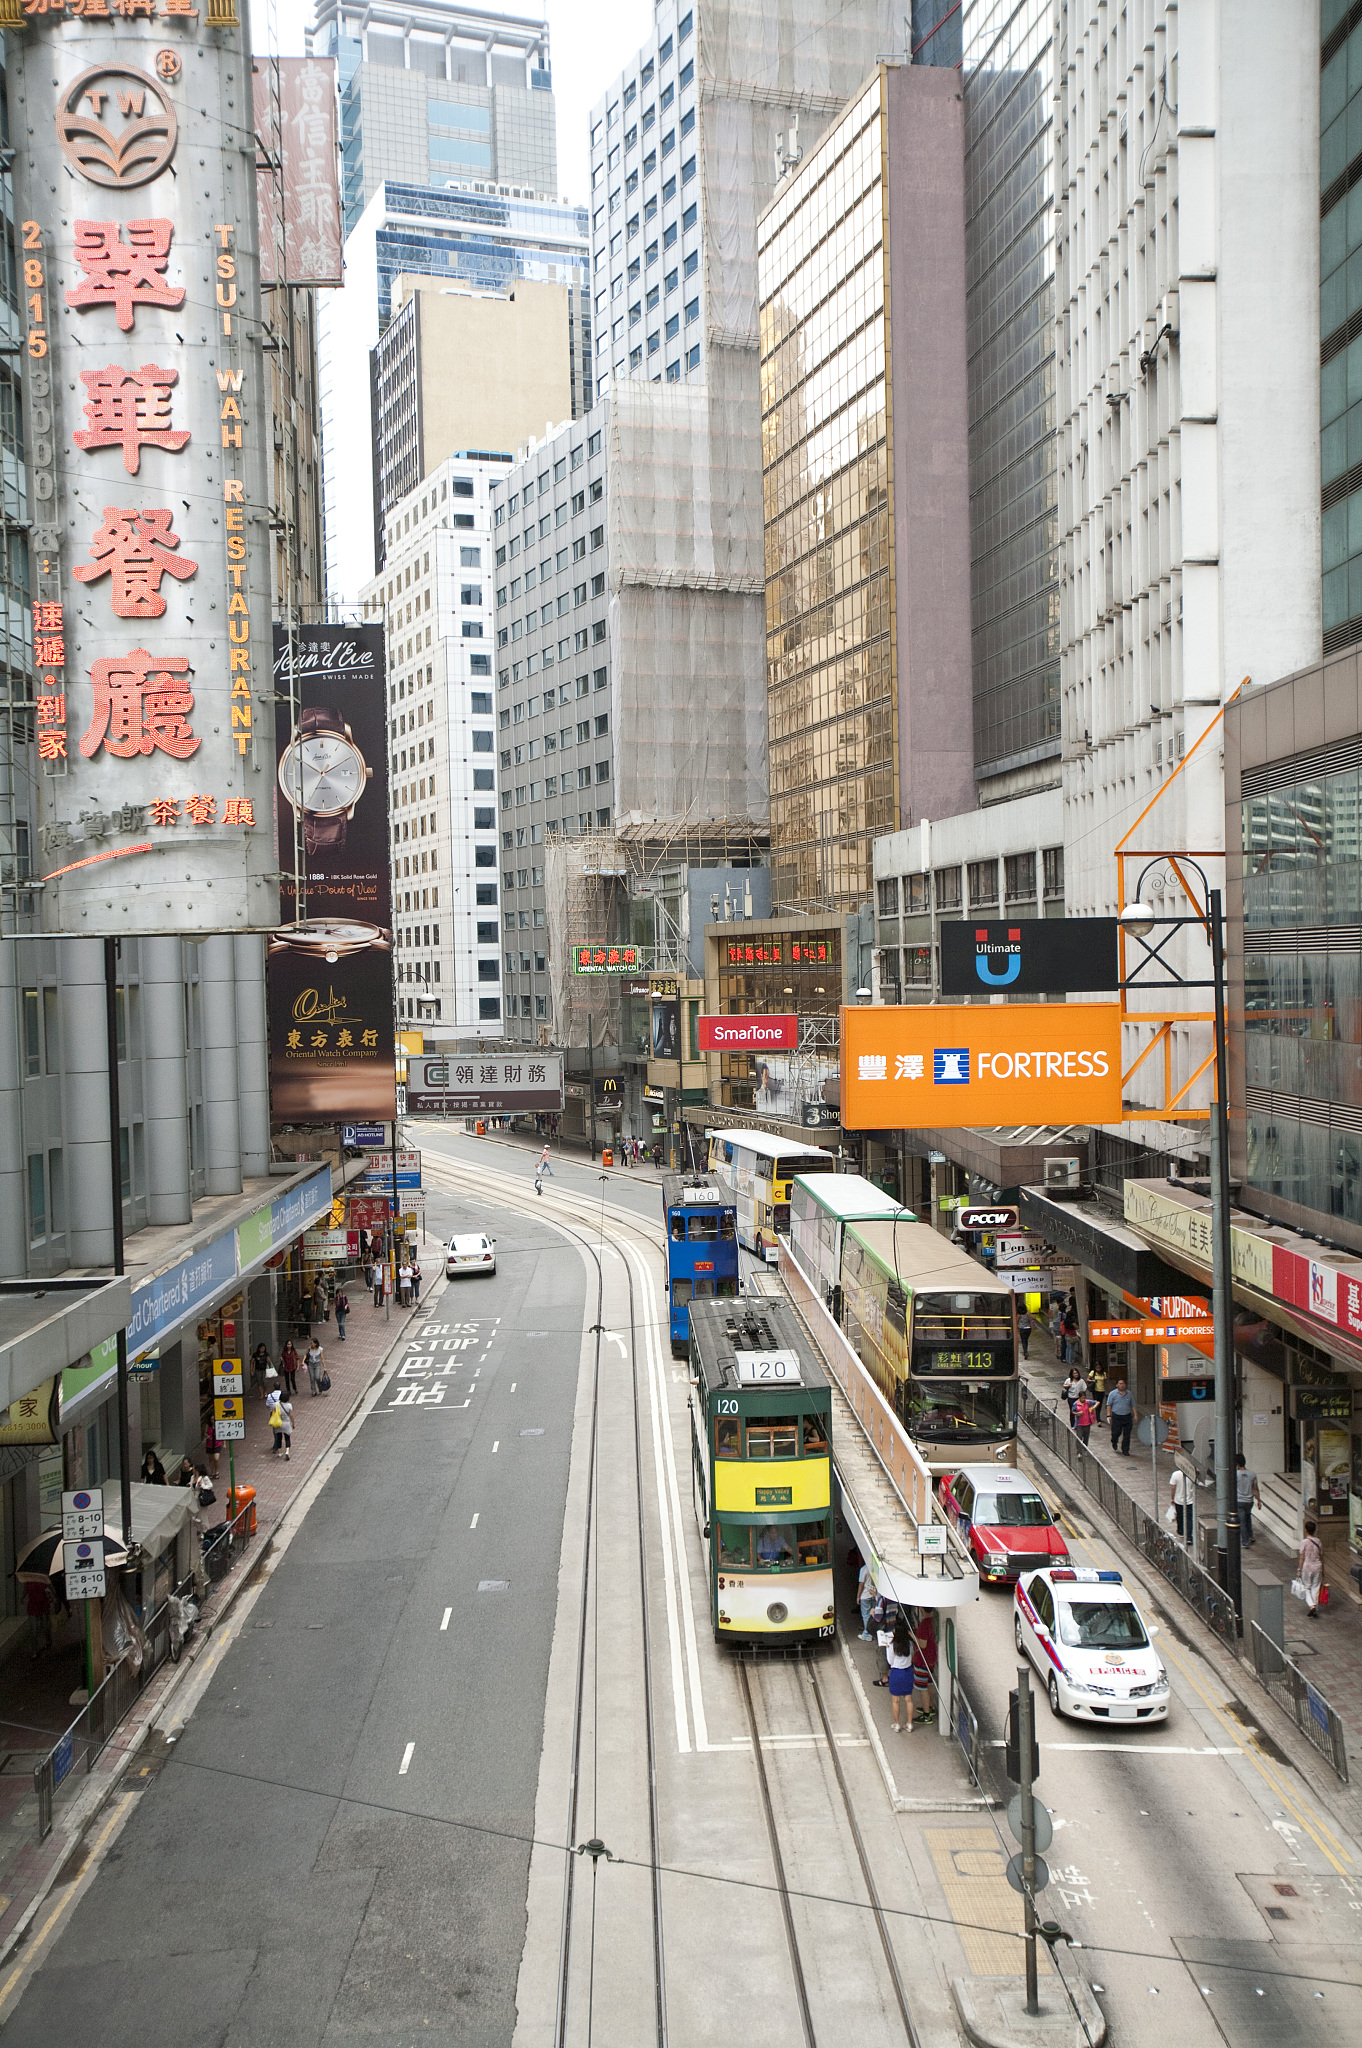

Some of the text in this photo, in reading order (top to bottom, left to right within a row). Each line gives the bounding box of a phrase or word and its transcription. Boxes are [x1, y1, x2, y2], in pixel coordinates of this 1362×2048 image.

[21, 220, 48, 358] 2815
[30, 368, 54, 500] 3000
[64, 218, 202, 759] 翠華餐廳
[214, 224, 252, 756] TSUI WAH RESTAURANT
[315, 884, 346, 896] Point
[347, 884, 356, 897] of
[356, 882, 377, 896] View
[976, 943, 1021, 953] Ultimate
[578, 965, 605, 973] ORIENTAL
[285, 1028, 379, 1050] 東方表行
[714, 1025, 783, 1042] SmarTone
[285, 1049, 379, 1059] Oriental Watch Company
[317, 1060, 333, 1068] Since
[857, 1054, 925, 1081] 豐澤
[978, 1050, 1110, 1079] FORTRESS
[455, 1064, 546, 1084] 領達財務
[693, 1191, 714, 1201] 160
[968, 1213, 1010, 1225] PCCW
[142, 1279, 180, 1327] Chartered
[420, 1323, 480, 1337] BUS
[406, 1337, 480, 1352] STOP
[937, 1352, 962, 1363] 彩虹
[967, 1352, 992, 1368] 113
[396, 1354, 464, 1380] 巴士
[751, 1361, 786, 1379] 120
[219, 1384, 238, 1393] 終止
[388, 1380, 449, 1406] 站
[19, 1398, 39, 1418] 家
[717, 1399, 739, 1414] 120
[26, 1422, 47, 1431] 3000
[227, 1421, 243, 1429] 7-10
[78, 1513, 101, 1523] 8-10
[78, 1525, 98, 1536] 5-7
[80, 1574, 103, 1584] 8-10
[81, 1586, 98, 1595] 4-7
[818, 1624, 835, 1638] 120
